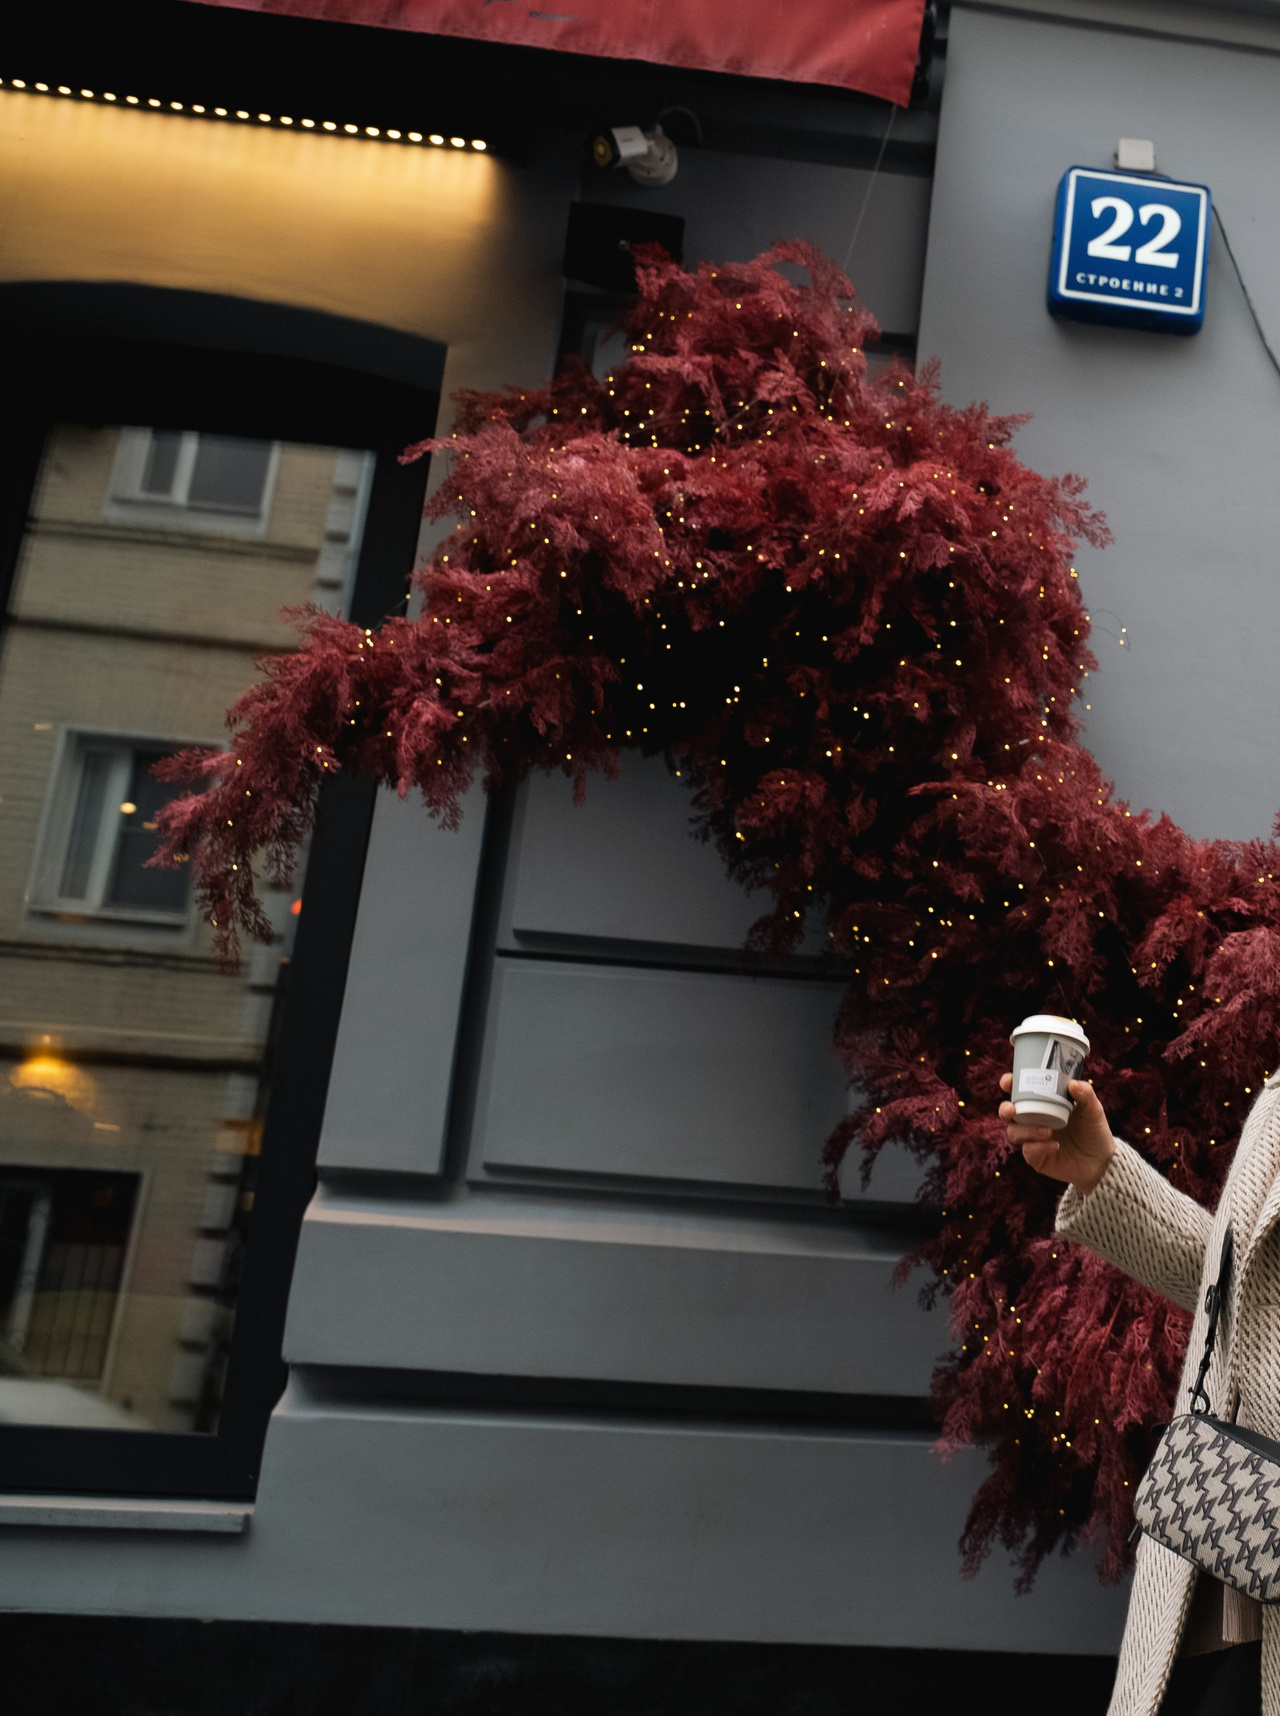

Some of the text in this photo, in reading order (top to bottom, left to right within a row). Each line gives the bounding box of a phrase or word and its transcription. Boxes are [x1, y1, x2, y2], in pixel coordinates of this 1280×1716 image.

[1087, 196, 1182, 269] 22
[1076, 272, 1184, 298] СТРОЕНИЕ 2
